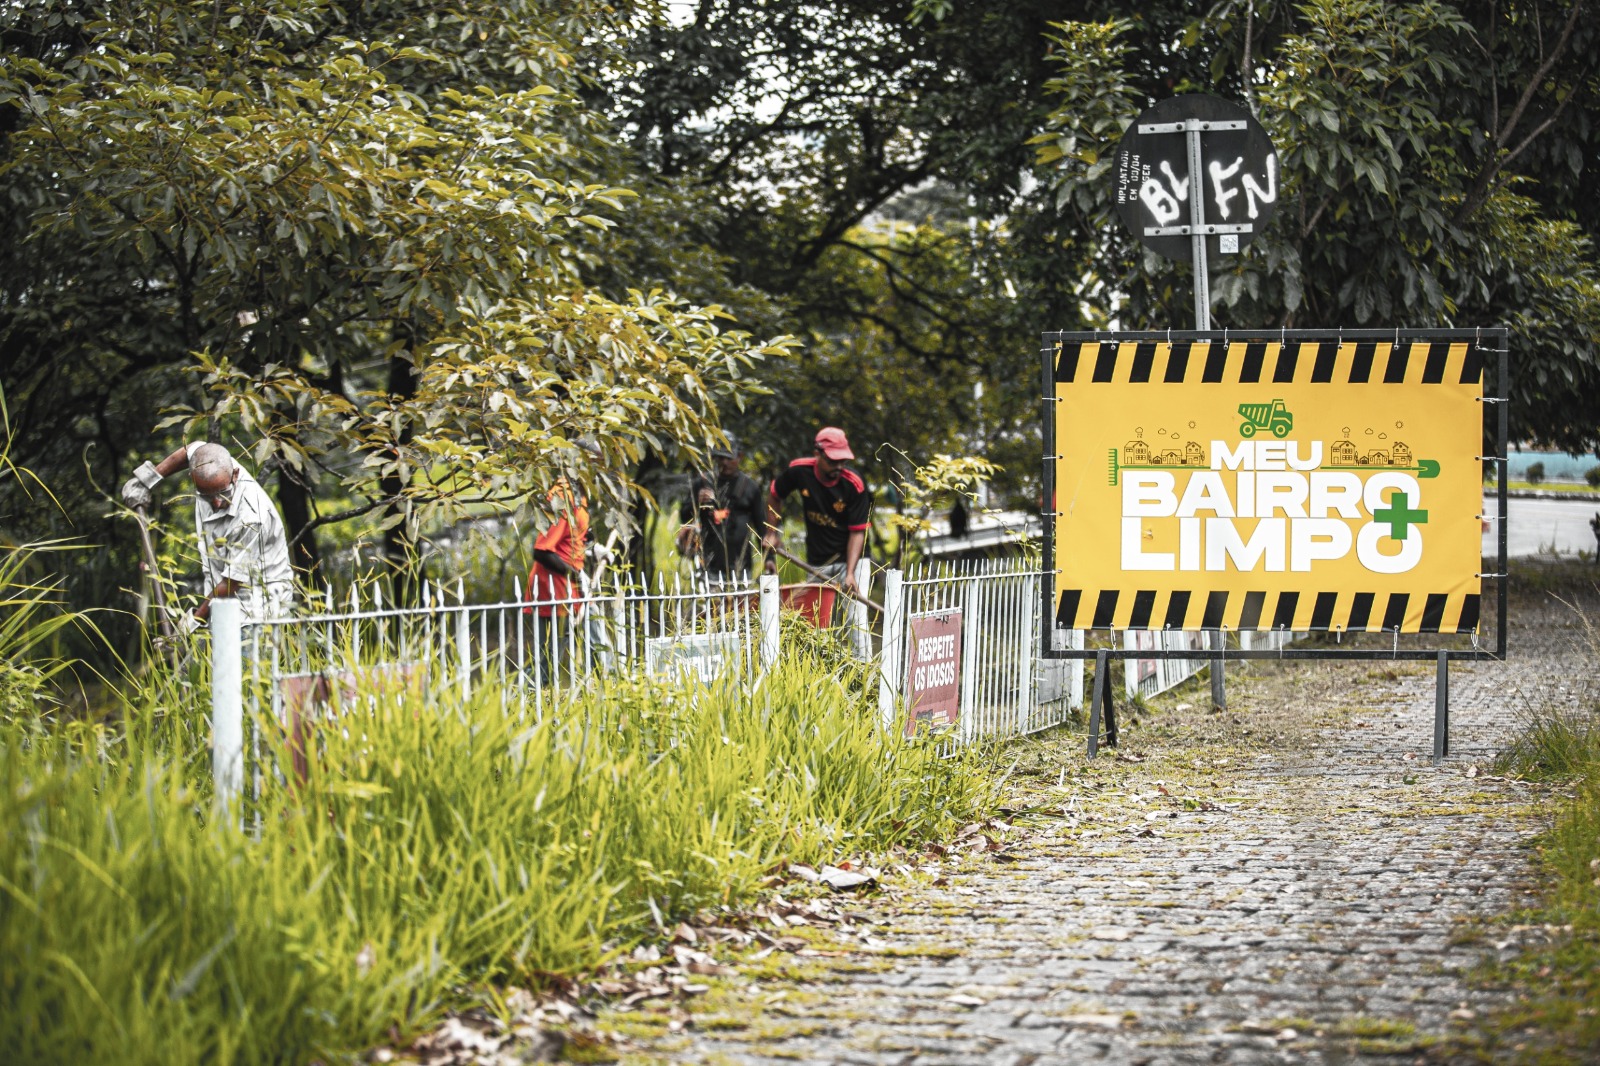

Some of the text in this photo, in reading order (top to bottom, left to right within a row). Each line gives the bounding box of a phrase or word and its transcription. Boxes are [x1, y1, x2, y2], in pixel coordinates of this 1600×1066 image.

[1118, 150, 1129, 204] IMPLANTADO
[1129, 189, 1138, 201] EM
[1210, 440, 1323, 471] MEU
[1121, 471, 1420, 518] BAIRRO
[1120, 517, 1423, 573] LIMPO
[918, 634, 955, 662] RESPEITE
[914, 660, 955, 691] OS IDOSOS
